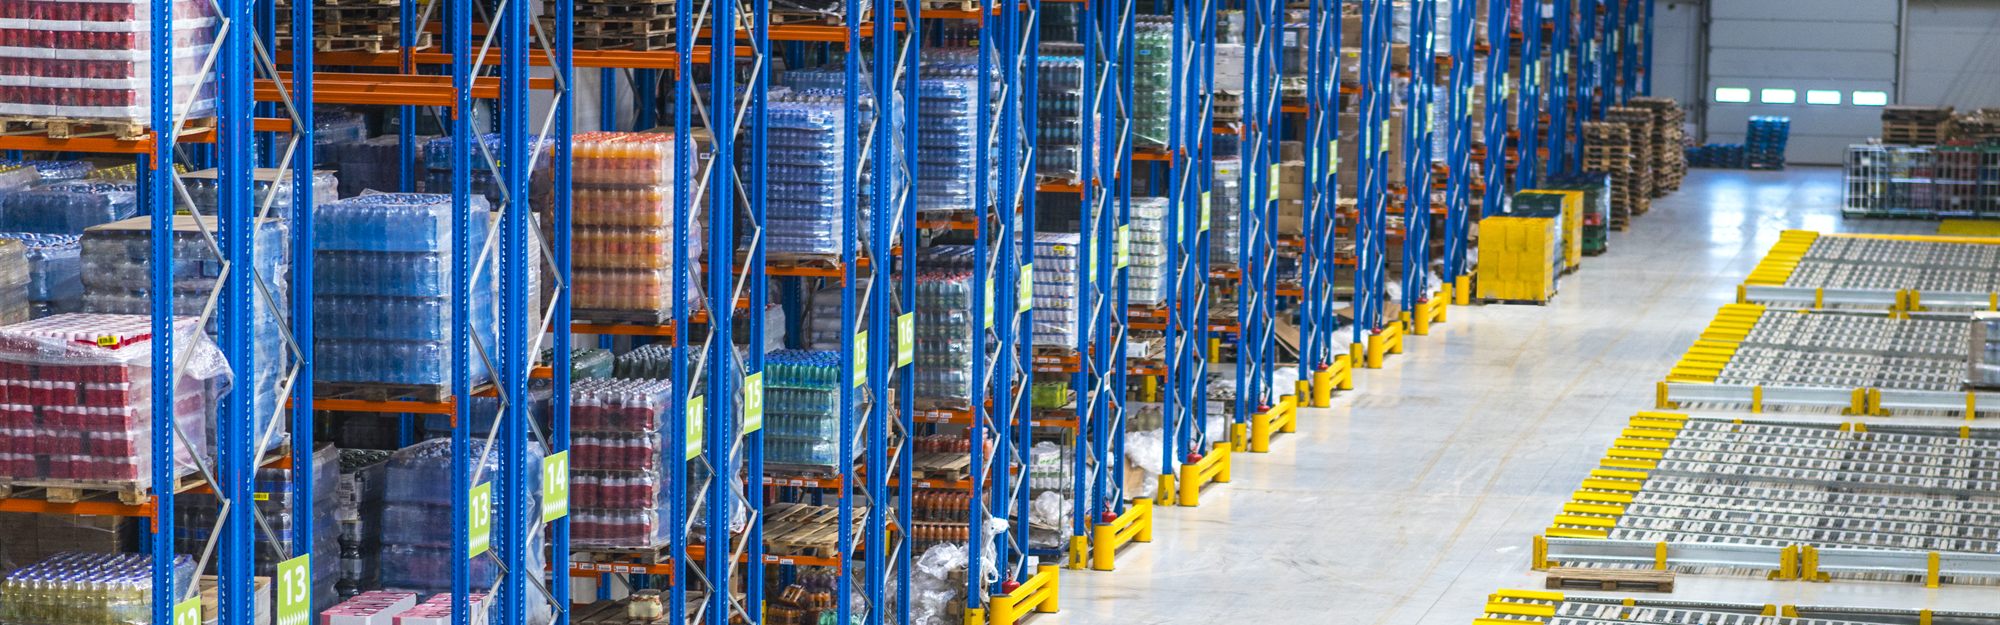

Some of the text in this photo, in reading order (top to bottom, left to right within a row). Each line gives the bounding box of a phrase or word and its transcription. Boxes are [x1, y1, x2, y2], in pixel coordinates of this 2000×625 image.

[901, 319, 912, 346] 16
[857, 337, 866, 365] 15
[748, 379, 761, 410] 15
[689, 403, 701, 435] 14
[547, 459, 566, 495] 14
[472, 492, 488, 529] 13
[283, 564, 307, 606] 13
